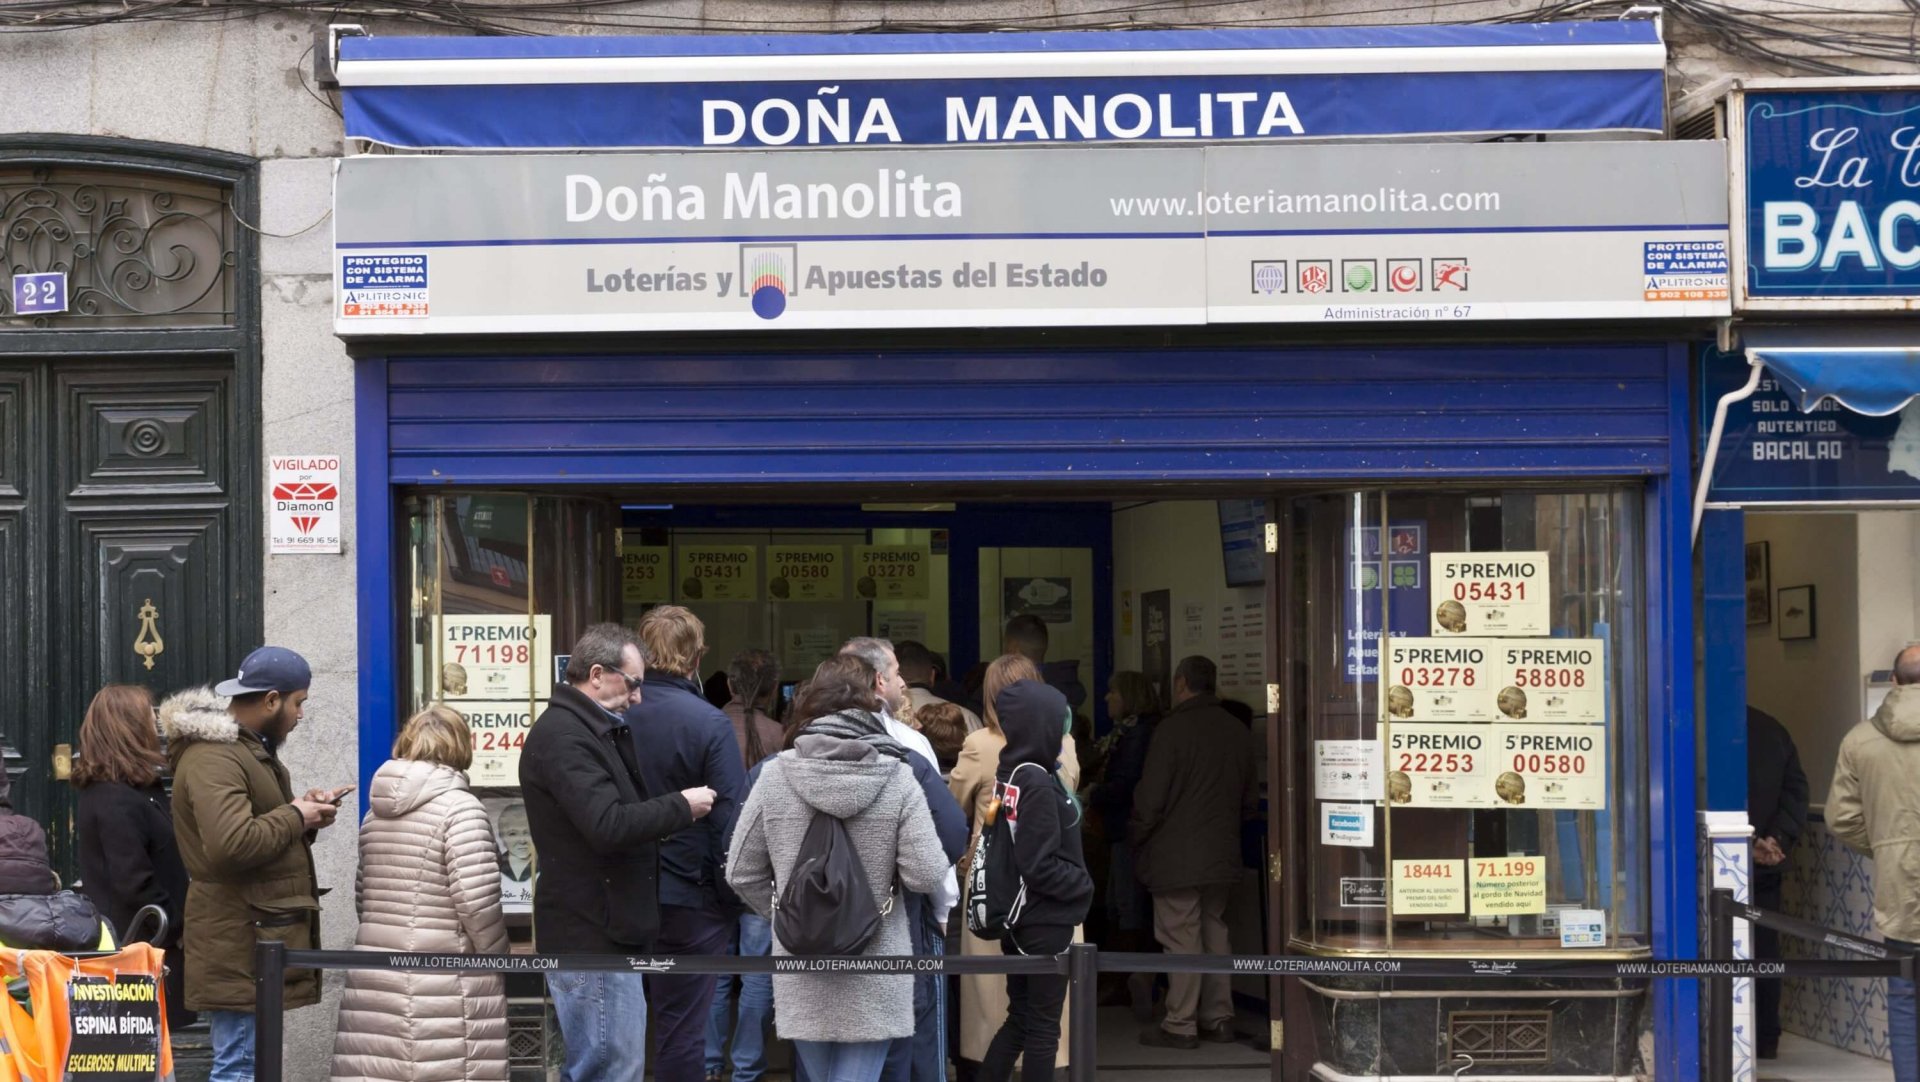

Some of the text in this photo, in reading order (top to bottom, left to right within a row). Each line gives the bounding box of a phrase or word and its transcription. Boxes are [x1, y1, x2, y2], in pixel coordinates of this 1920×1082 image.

[702, 85, 1306, 146] DOÑA MANOLITA
[1794, 126, 1873, 189] La
[565, 168, 963, 223] Doña Manolita
[1110, 188, 1502, 217] www.loteriamanolita.com
[1764, 200, 1920, 272] BAC
[1648, 243, 1725, 251] PROTEGIDO
[347, 257, 423, 266] PROTEGIDO
[1675, 252, 1727, 260] SISTEMA
[346, 266, 424, 275] CON SISTEMA
[1669, 261, 1728, 269] ALARMA
[346, 275, 425, 284] DE ALARMA
[587, 262, 1108, 298] Loterías y Apuestas del Estado
[23, 281, 56, 306] 22
[1324, 307, 1430, 320] Administración
[1453, 305, 1472, 318] 67
[1752, 401, 1790, 413] SOLO
[1758, 421, 1837, 433] AUTENTICO
[1753, 441, 1842, 460] BACALAO
[272, 460, 338, 471] VIGILADO
[699, 552, 748, 563] PREMIO
[785, 552, 834, 562] PREMIO
[872, 551, 920, 562] PREMIO
[694, 565, 742, 578] 05431
[781, 565, 829, 578] 00580
[867, 565, 915, 577] 03278
[1460, 563, 1535, 578] PREMIO
[1454, 582, 1525, 601] 05431
[462, 625, 537, 641] PREMIO
[455, 644, 529, 664] 71198
[1408, 649, 1484, 664] PREMIO
[1521, 650, 1592, 665] PREMIO
[1401, 668, 1475, 687] 03278
[1515, 669, 1585, 688] 58808
[1407, 735, 1482, 750] PREMIO
[1520, 736, 1593, 751] PREMIO
[1399, 753, 1474, 773] 22253
[1513, 754, 1585, 774] 00580
[1403, 864, 1452, 879] 18441
[1477, 862, 1535, 877] 71.199
[1507, 880, 1539, 888] posterior
[1481, 891, 1502, 899] gordo
[389, 956, 559, 970] WWW.LOTERIAMANOLITA.COM
[775, 960, 944, 971] WWW.LOTERIAMANOLITA.COM
[1233, 959, 1401, 972] WWW.LOTERIAMANOLITA.COM
[1616, 963, 1786, 974] WWW.LOTERIAMANOLITA.COM
[74, 978, 155, 1001] INVESTIGACIÓN
[75, 1010, 154, 1034] ESPINA BÍFIDA
[68, 1054, 156, 1072] ESCLEROSIS MULTIPLE
